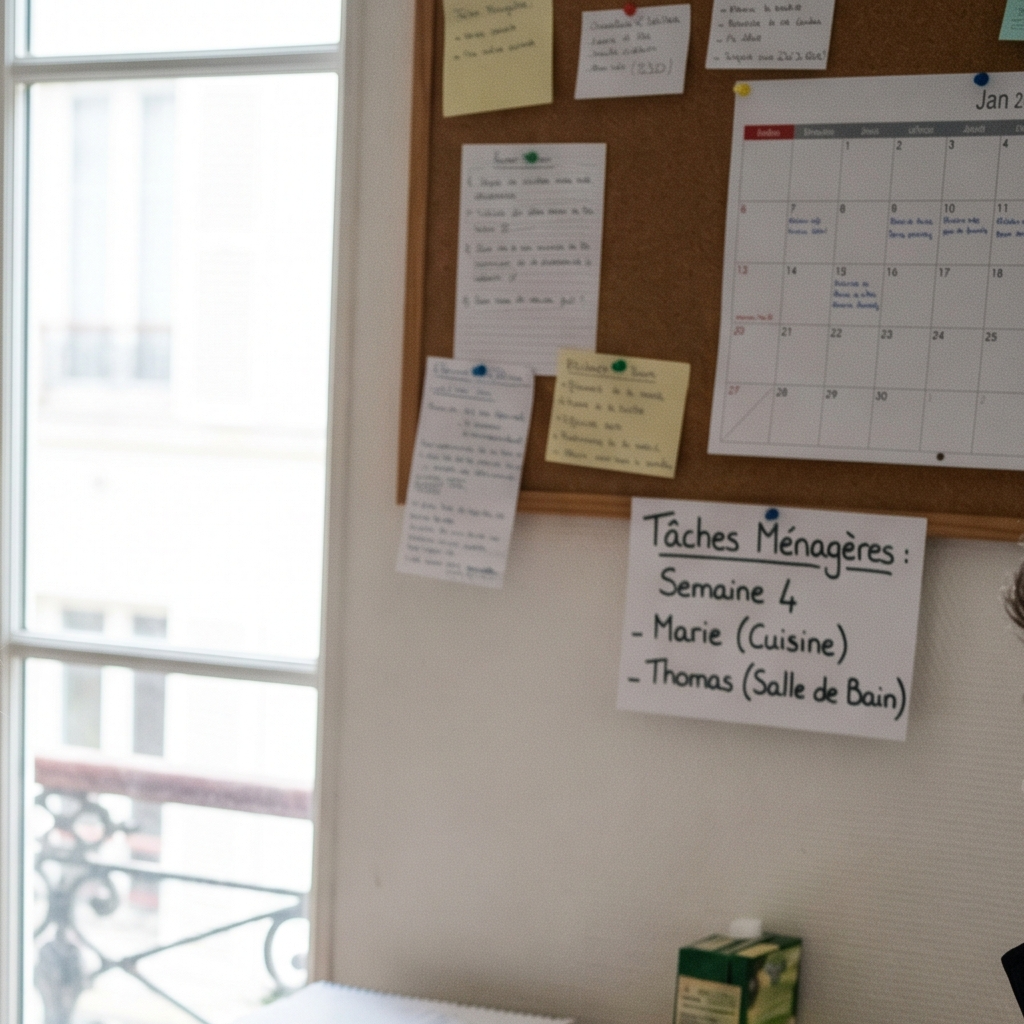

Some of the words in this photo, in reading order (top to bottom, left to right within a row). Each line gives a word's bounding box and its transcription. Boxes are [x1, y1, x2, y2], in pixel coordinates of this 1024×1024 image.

[976, 89, 1009, 110] Jan
[896, 140, 903, 150] 2
[948, 139, 955, 150] 3
[1002, 138, 1009, 148] 4
[790, 203, 796, 213] 7
[839, 203, 846, 214] 8
[891, 203, 898, 213] 9
[944, 203, 956, 213] 10
[997, 203, 1008, 213] 11
[787, 265, 797, 275] 14
[836, 266, 847, 276] 15
[887, 267, 898, 277] 16
[939, 267, 950, 277] 17
[992, 268, 1003, 278] 18
[781, 327, 792, 337] 21
[830, 328, 842, 338] 22
[881, 329, 893, 340] 23
[932, 330, 944, 340] 24
[985, 332, 997, 342] 25
[776, 387, 788, 397] 28
[825, 389, 838, 399] 29
[876, 391, 888, 401] 30
[643, 511, 740, 552] Tâches
[658, 567, 765, 604] Semaine
[779, 578, 798, 614] 4
[654, 613, 723, 646] Marie
[736, 615, 849, 665] (Cuisine)
[645, 657, 734, 692] Thomas
[742, 662, 806, 702] (Salle
[813, 675, 839, 704] de
[846, 676, 907, 721] Bain)
